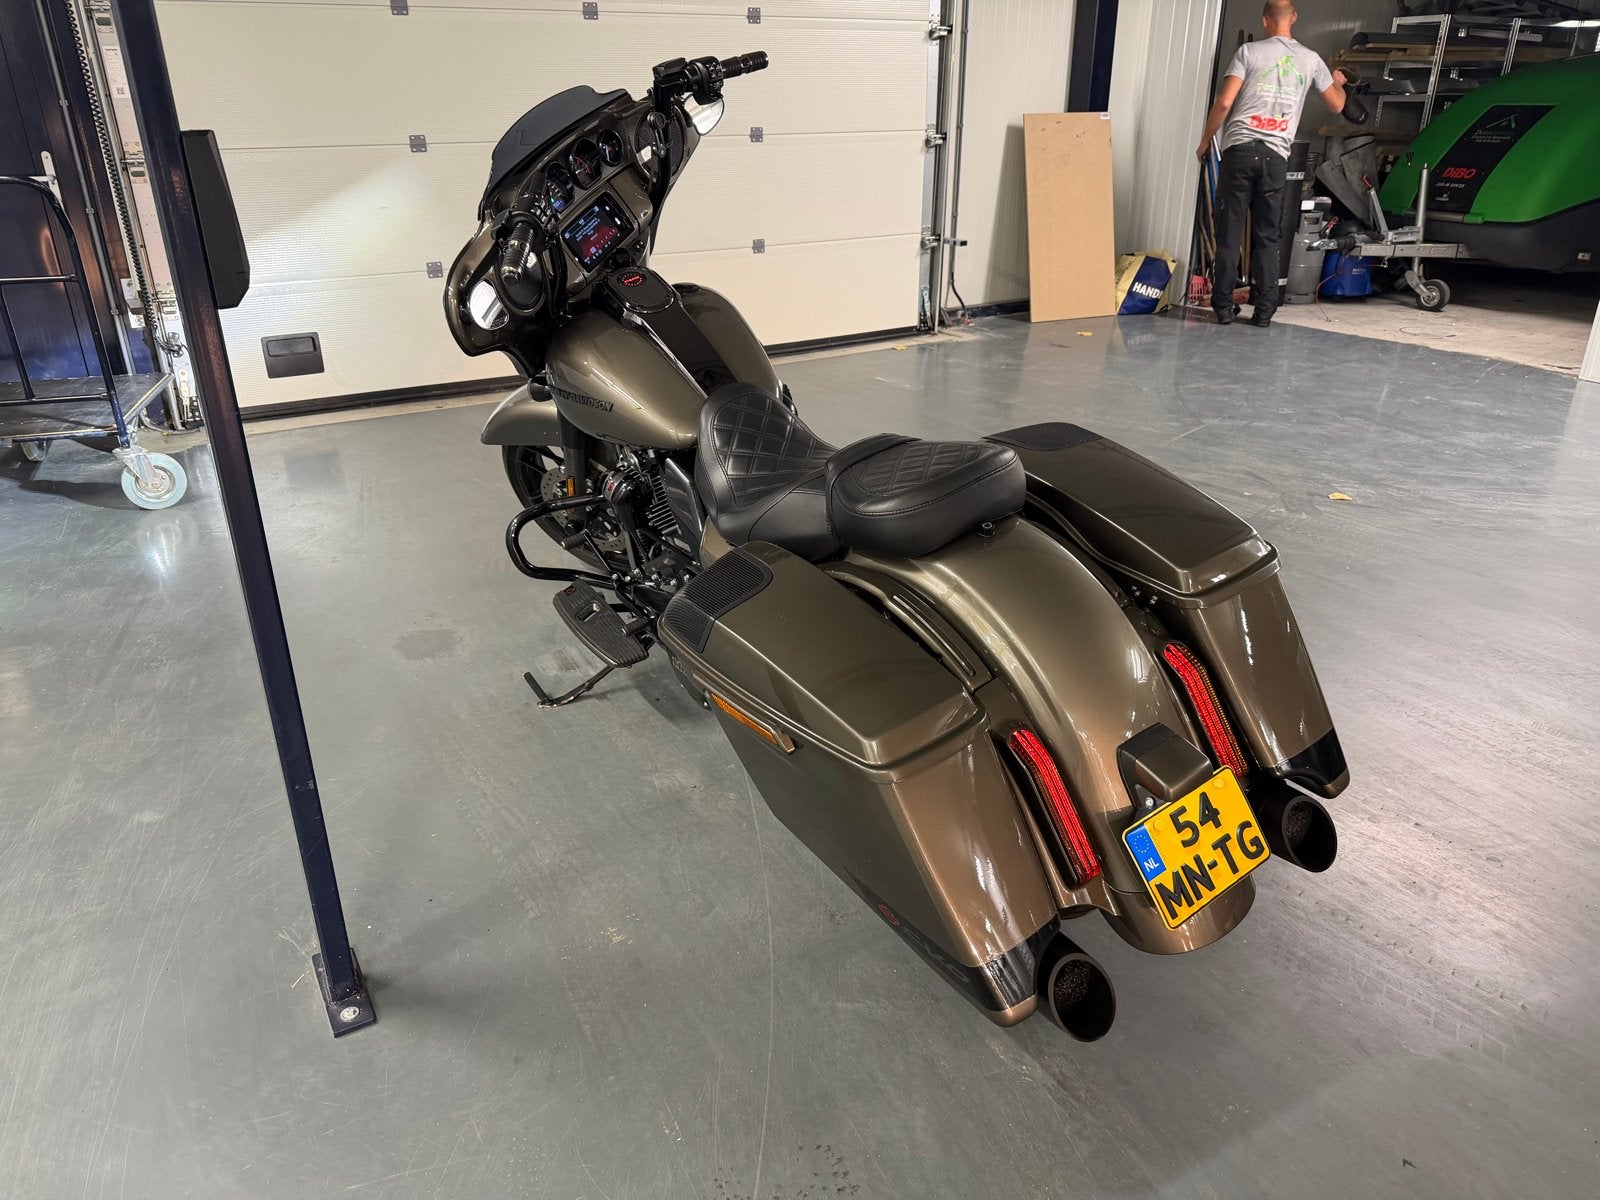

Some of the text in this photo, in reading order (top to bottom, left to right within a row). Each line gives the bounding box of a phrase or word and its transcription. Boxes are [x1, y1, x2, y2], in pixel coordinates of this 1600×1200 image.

[1169, 791, 1222, 848] 54
[1143, 858, 1160, 873] NL
[1155, 820, 1265, 920] MN-TG
